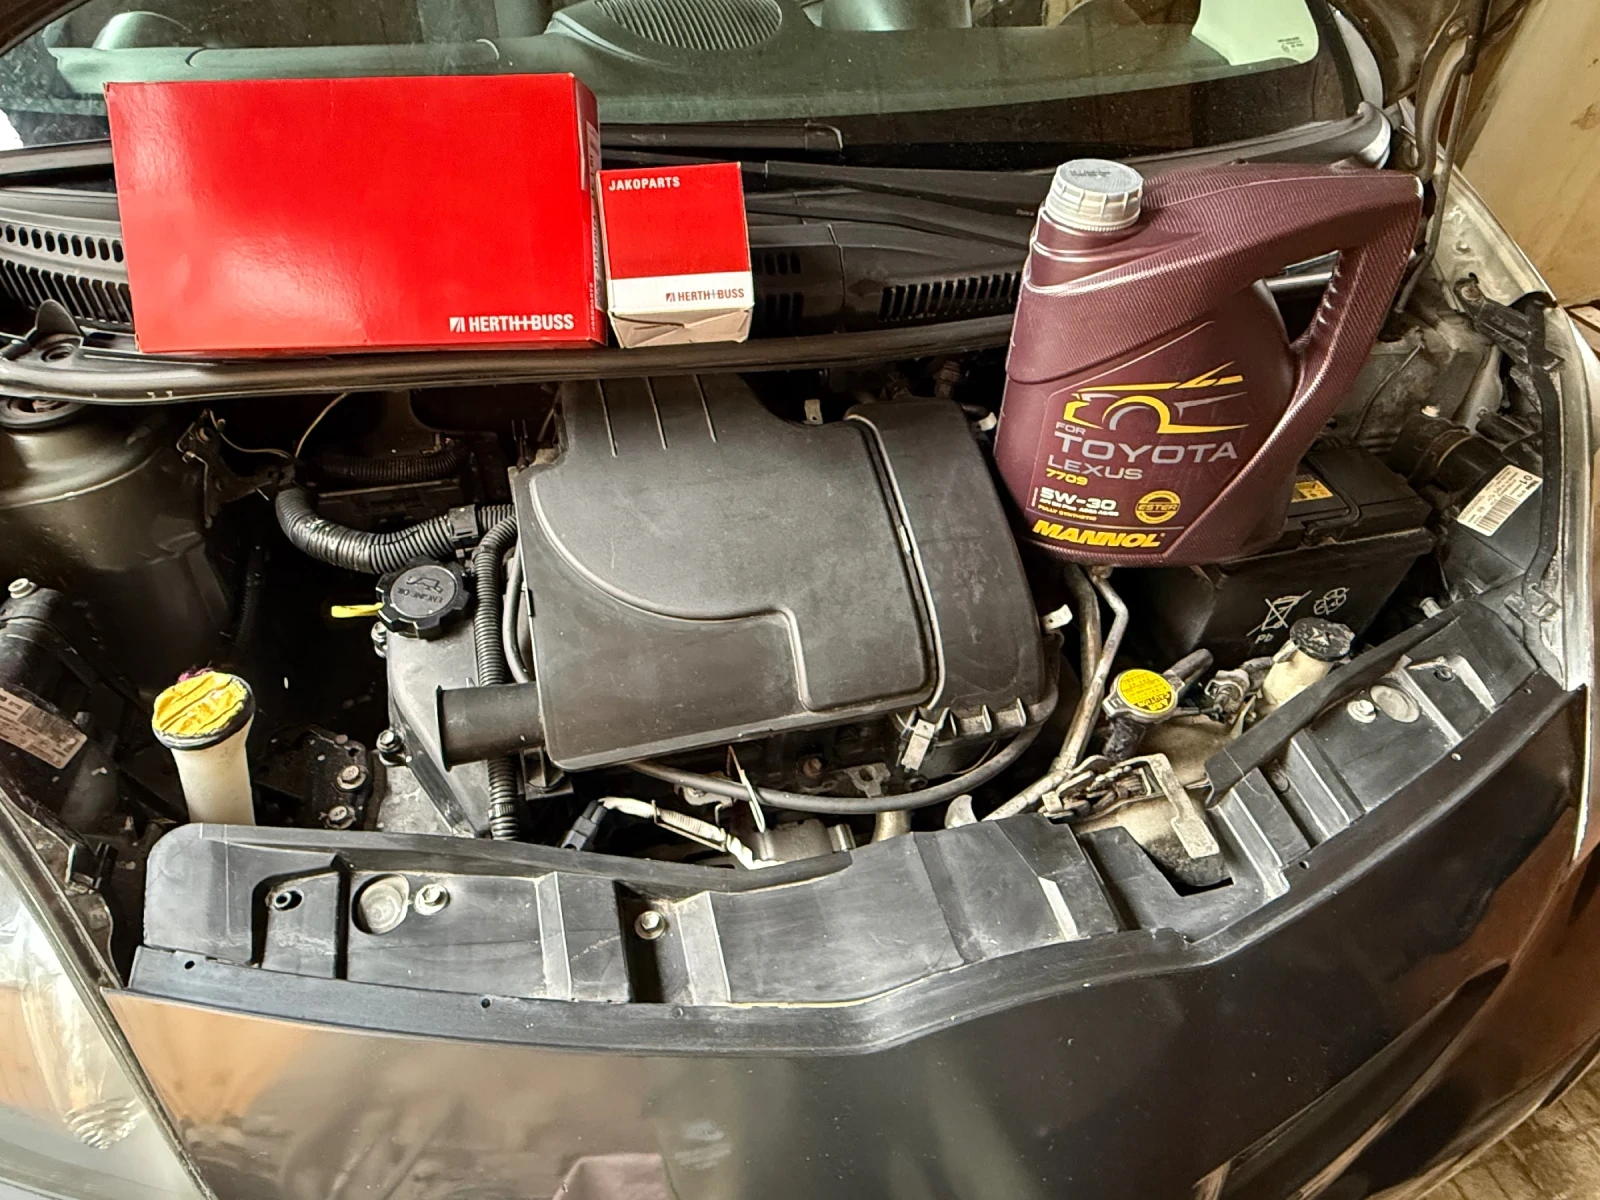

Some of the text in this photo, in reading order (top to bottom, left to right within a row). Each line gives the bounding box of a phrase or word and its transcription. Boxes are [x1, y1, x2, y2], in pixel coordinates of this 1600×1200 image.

[609, 176, 680, 191] JAKOPARTS
[678, 288, 745, 302] HERTH+BUSS
[469, 313, 575, 333] HERTH+BUSS
[1055, 421, 1087, 436] FOR
[1054, 430, 1238, 464] TOYOTA
[1045, 467, 1088, 486] 7709
[1047, 454, 1143, 480] LEXUS
[1039, 486, 1117, 511] 5W-30
[1137, 503, 1178, 511] ESTER
[1032, 519, 1162, 548] MANNOL
